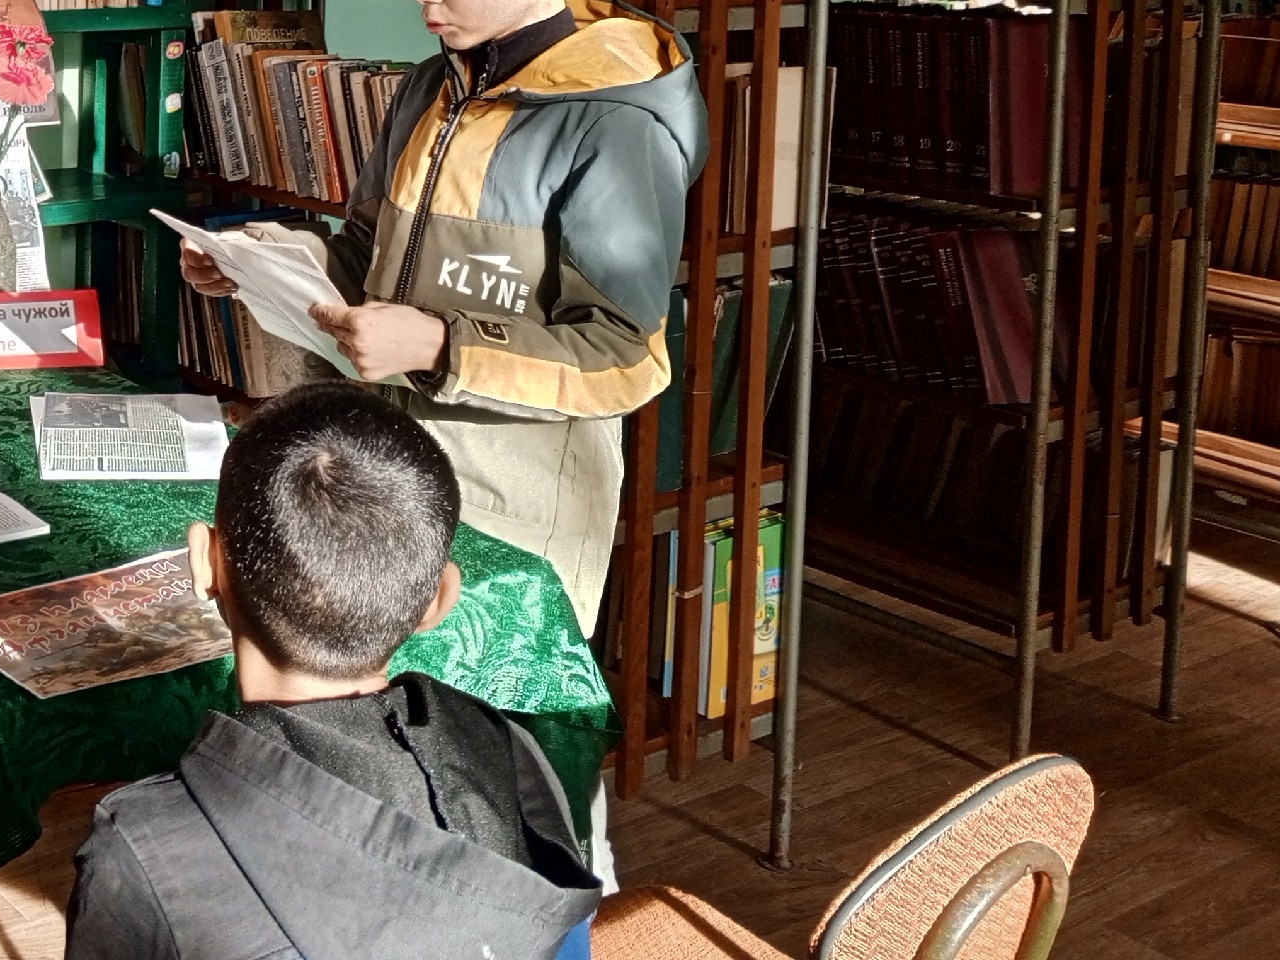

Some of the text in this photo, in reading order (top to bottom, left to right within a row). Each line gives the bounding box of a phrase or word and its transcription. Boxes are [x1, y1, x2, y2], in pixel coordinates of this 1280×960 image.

[245, 28, 307, 40] ПОВЕДЕНИЕ
[946, 140, 961, 152] 20
[438, 257, 517, 309] KLYN
[11, 302, 71, 324] чужой
[40, 559, 182, 618] пламени
